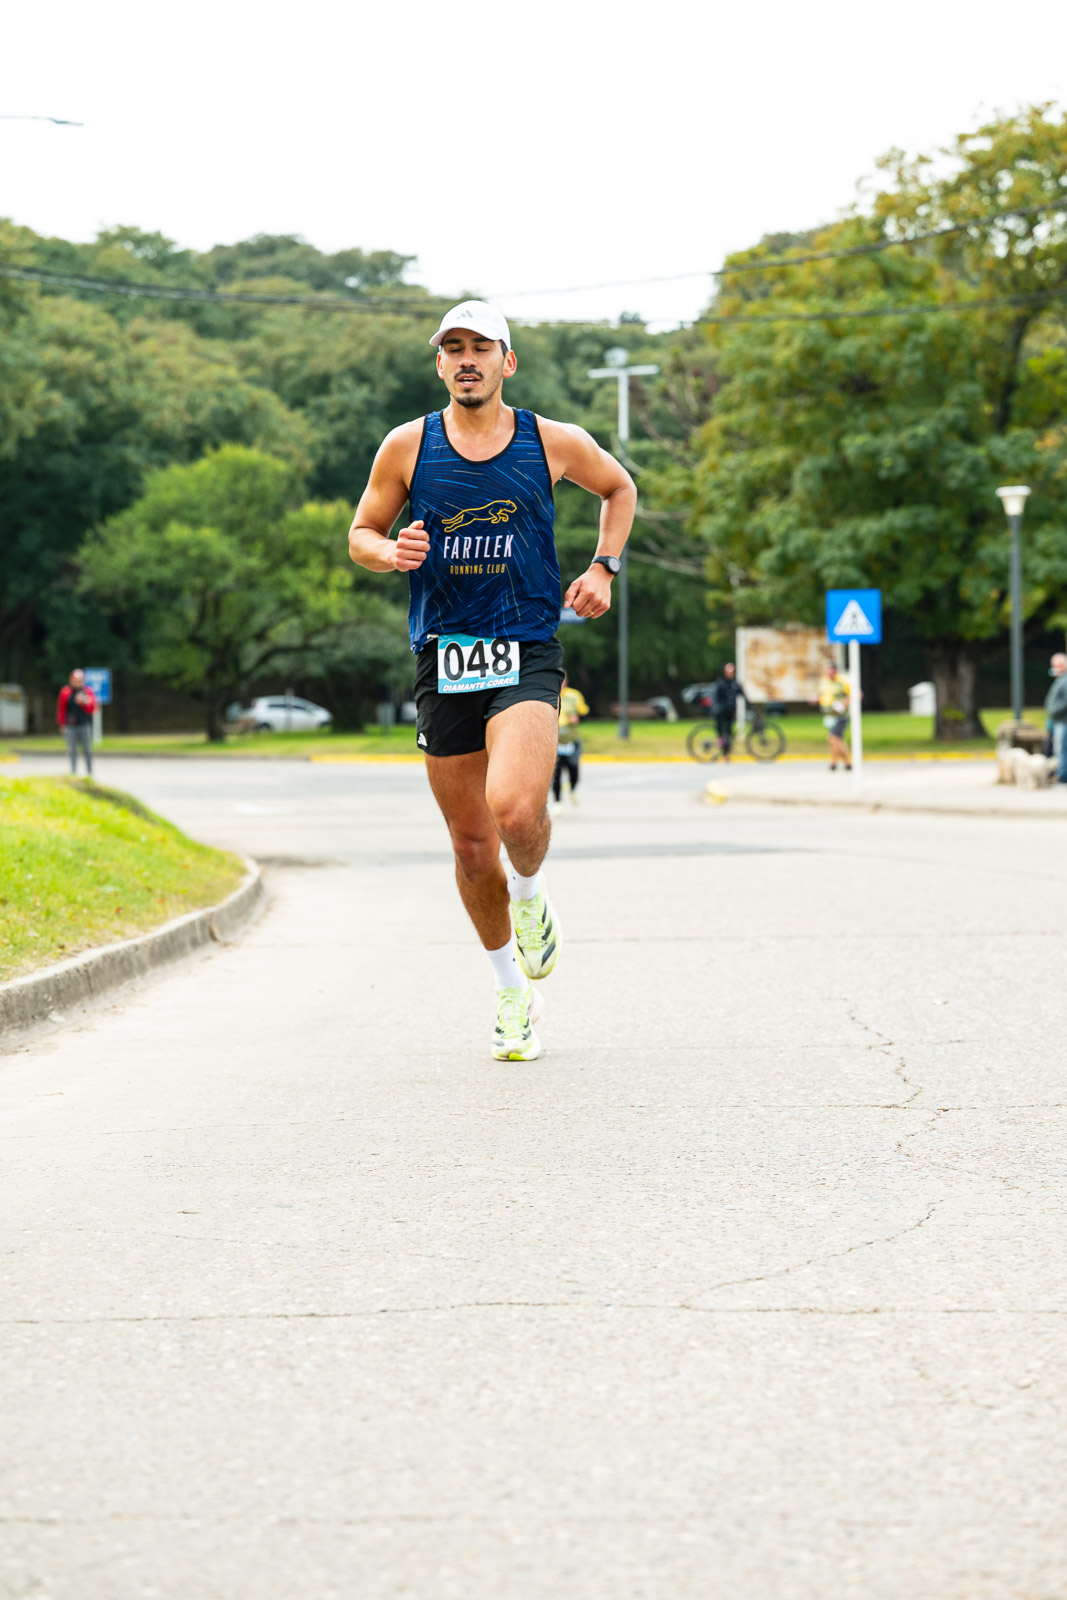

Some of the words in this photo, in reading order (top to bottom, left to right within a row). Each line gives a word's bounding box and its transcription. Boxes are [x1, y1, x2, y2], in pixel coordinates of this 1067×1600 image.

[443, 534, 514, 559] FARTLEK
[450, 564, 483, 575] RUNNING
[486, 563, 506, 574] CLUB
[444, 638, 513, 682] 048
[442, 681, 486, 692] DIAMANTE
[487, 676, 515, 687] CORRE
